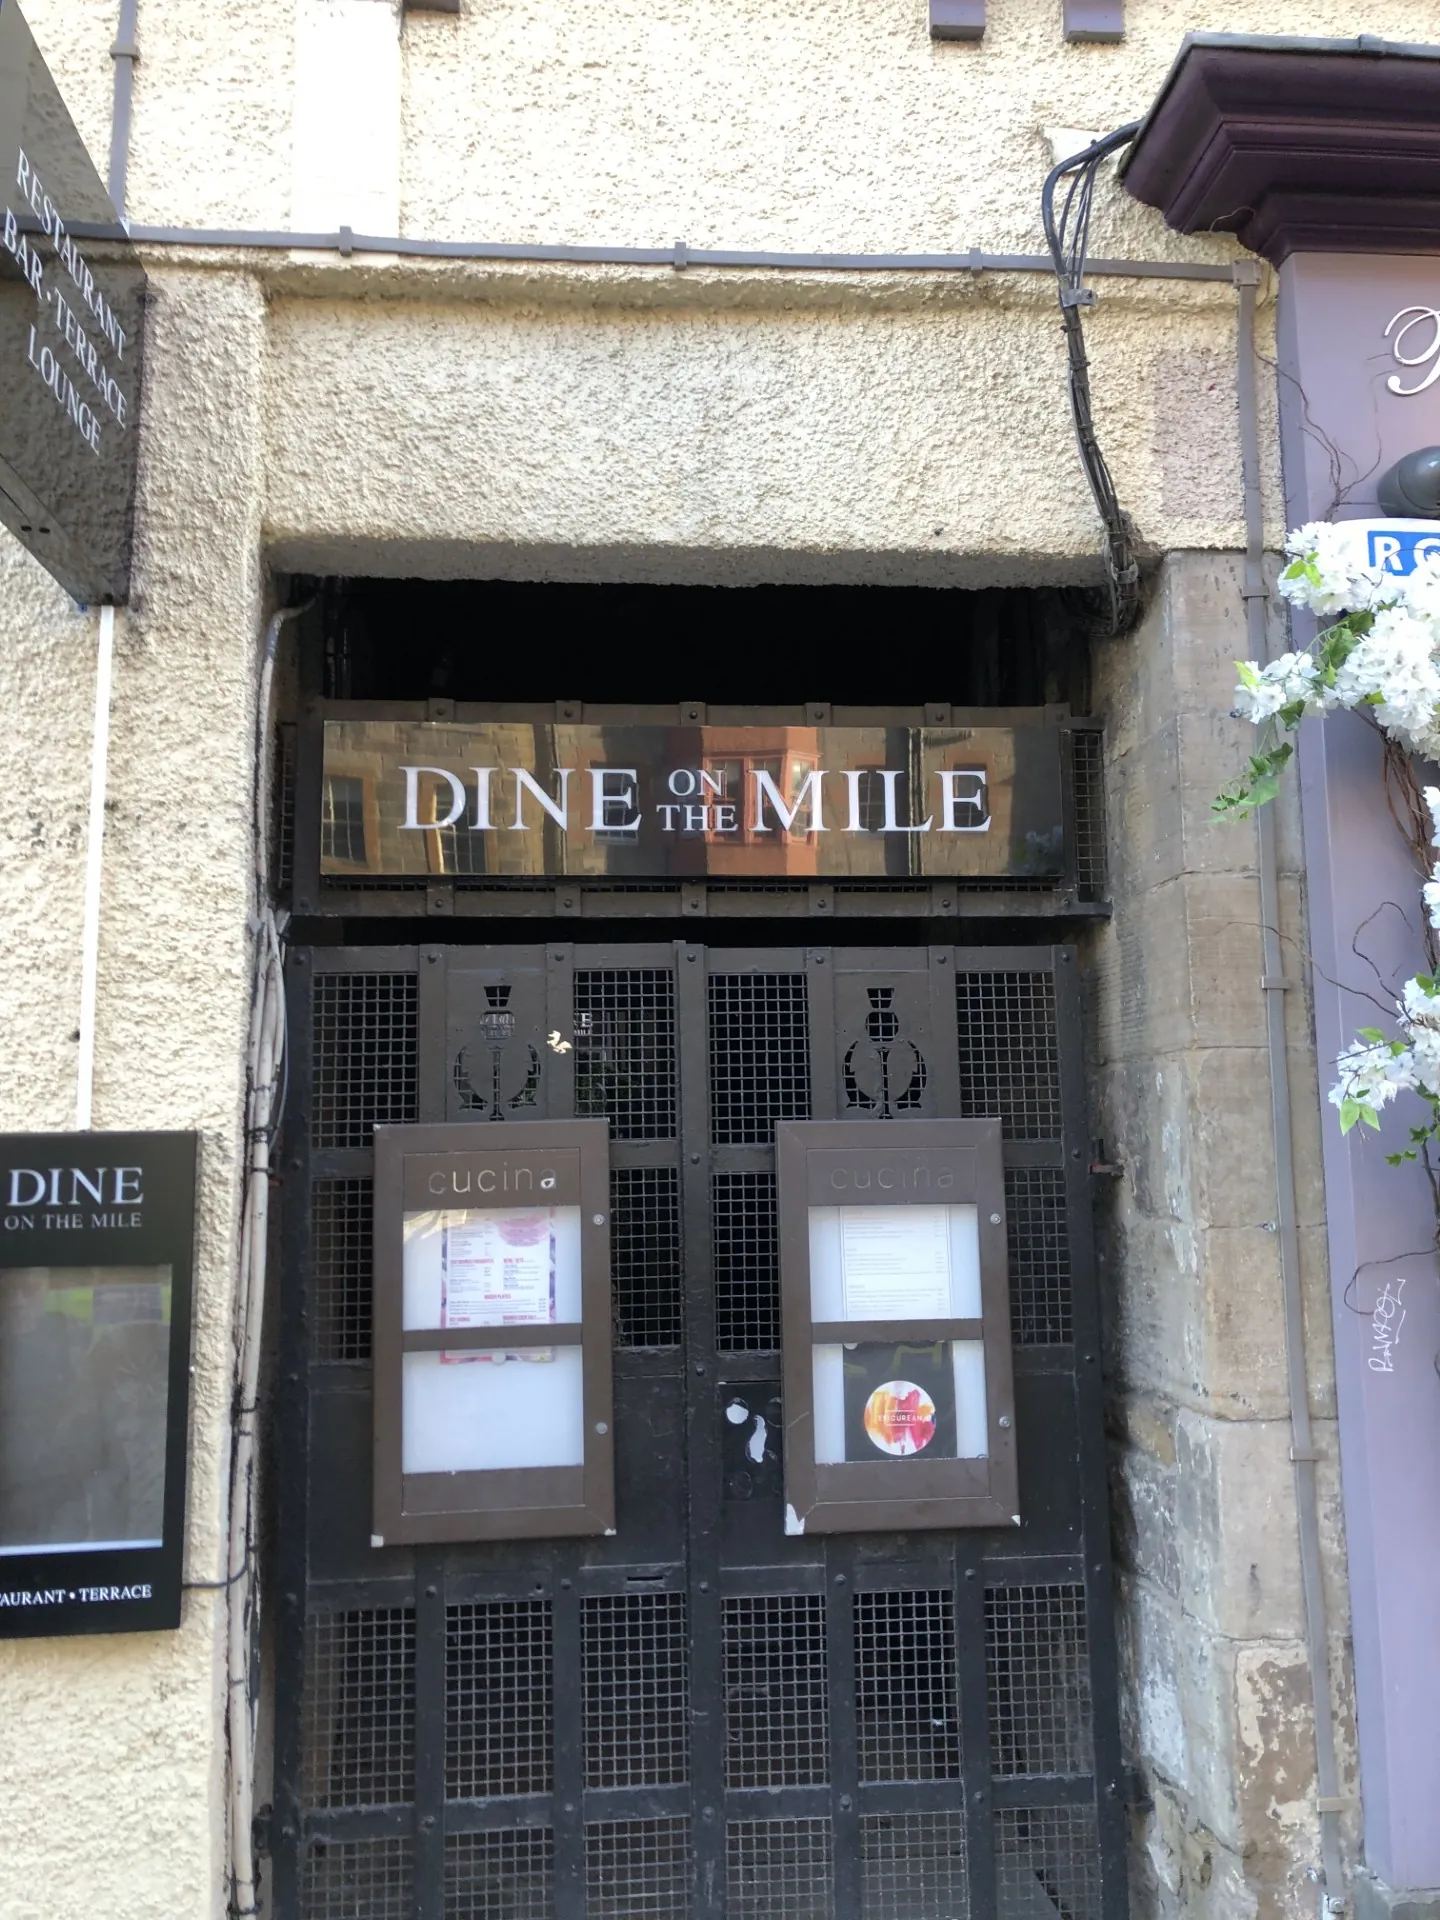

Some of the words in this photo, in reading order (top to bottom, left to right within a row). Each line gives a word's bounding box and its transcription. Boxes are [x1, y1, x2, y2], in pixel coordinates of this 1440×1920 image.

[16, 147, 126, 361] RESTAURANT
[2, 204, 43, 300] BAR
[54, 286, 127, 430] TERRACE
[28, 323, 101, 456] LOUNGE
[397, 766, 642, 831] DINE
[668, 768, 726, 797] ON
[656, 804, 738, 831] THE
[748, 770, 992, 832] MILE
[6, 1166, 144, 1206] DINE
[428, 1161, 557, 1194] cucina
[830, 1156, 954, 1189] cucina
[4, 1214, 35, 1230] ON
[42, 1213, 83, 1229] THE
[91, 1211, 142, 1228] MILE
[78, 1584, 152, 1603] TERRACE
